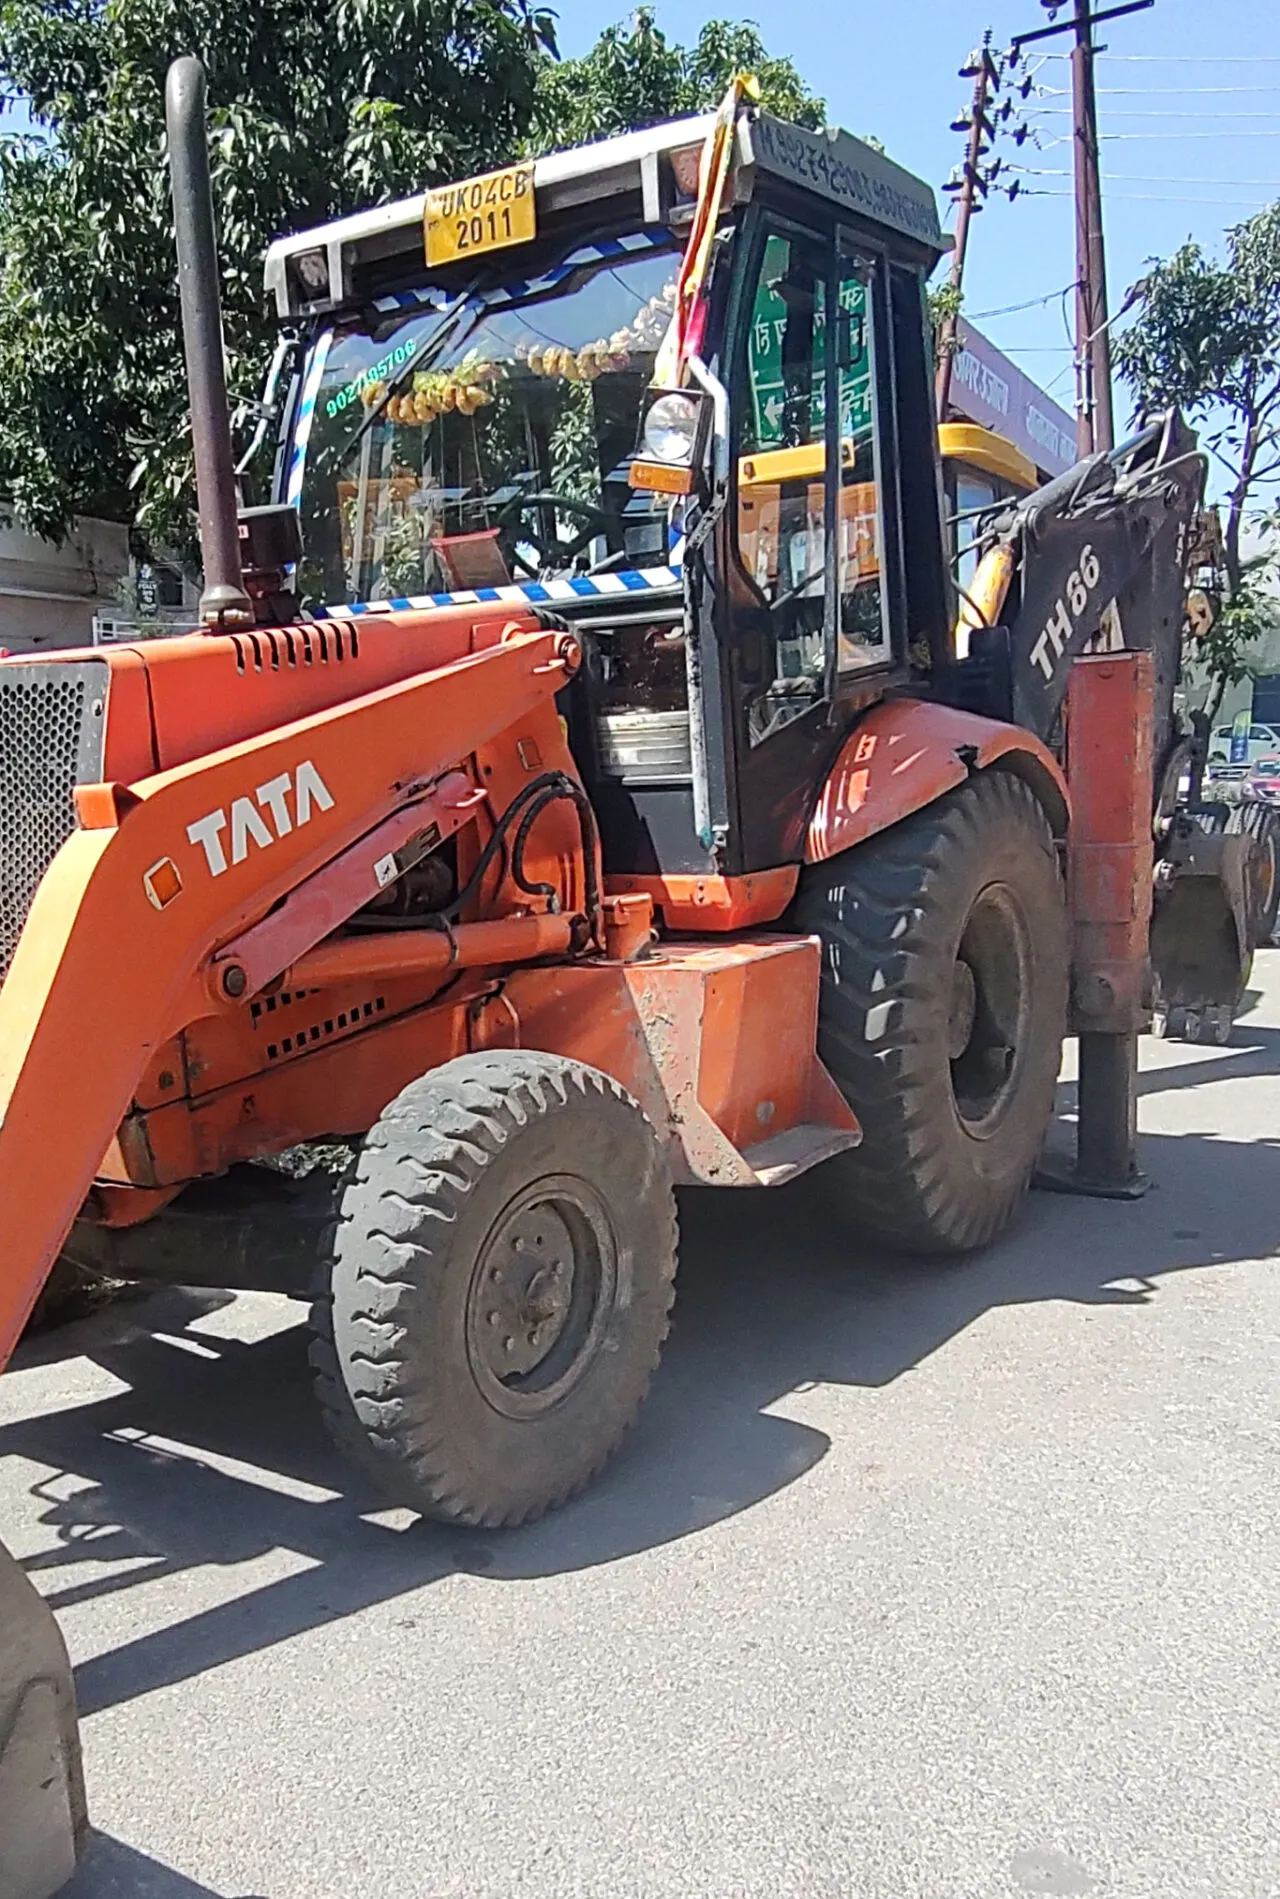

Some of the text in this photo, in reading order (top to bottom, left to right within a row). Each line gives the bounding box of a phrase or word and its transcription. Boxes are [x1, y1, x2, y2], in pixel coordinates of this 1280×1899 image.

[442, 169, 527, 218] UK04CB
[456, 207, 512, 250] 2011
[186, 760, 335, 877] TATA
